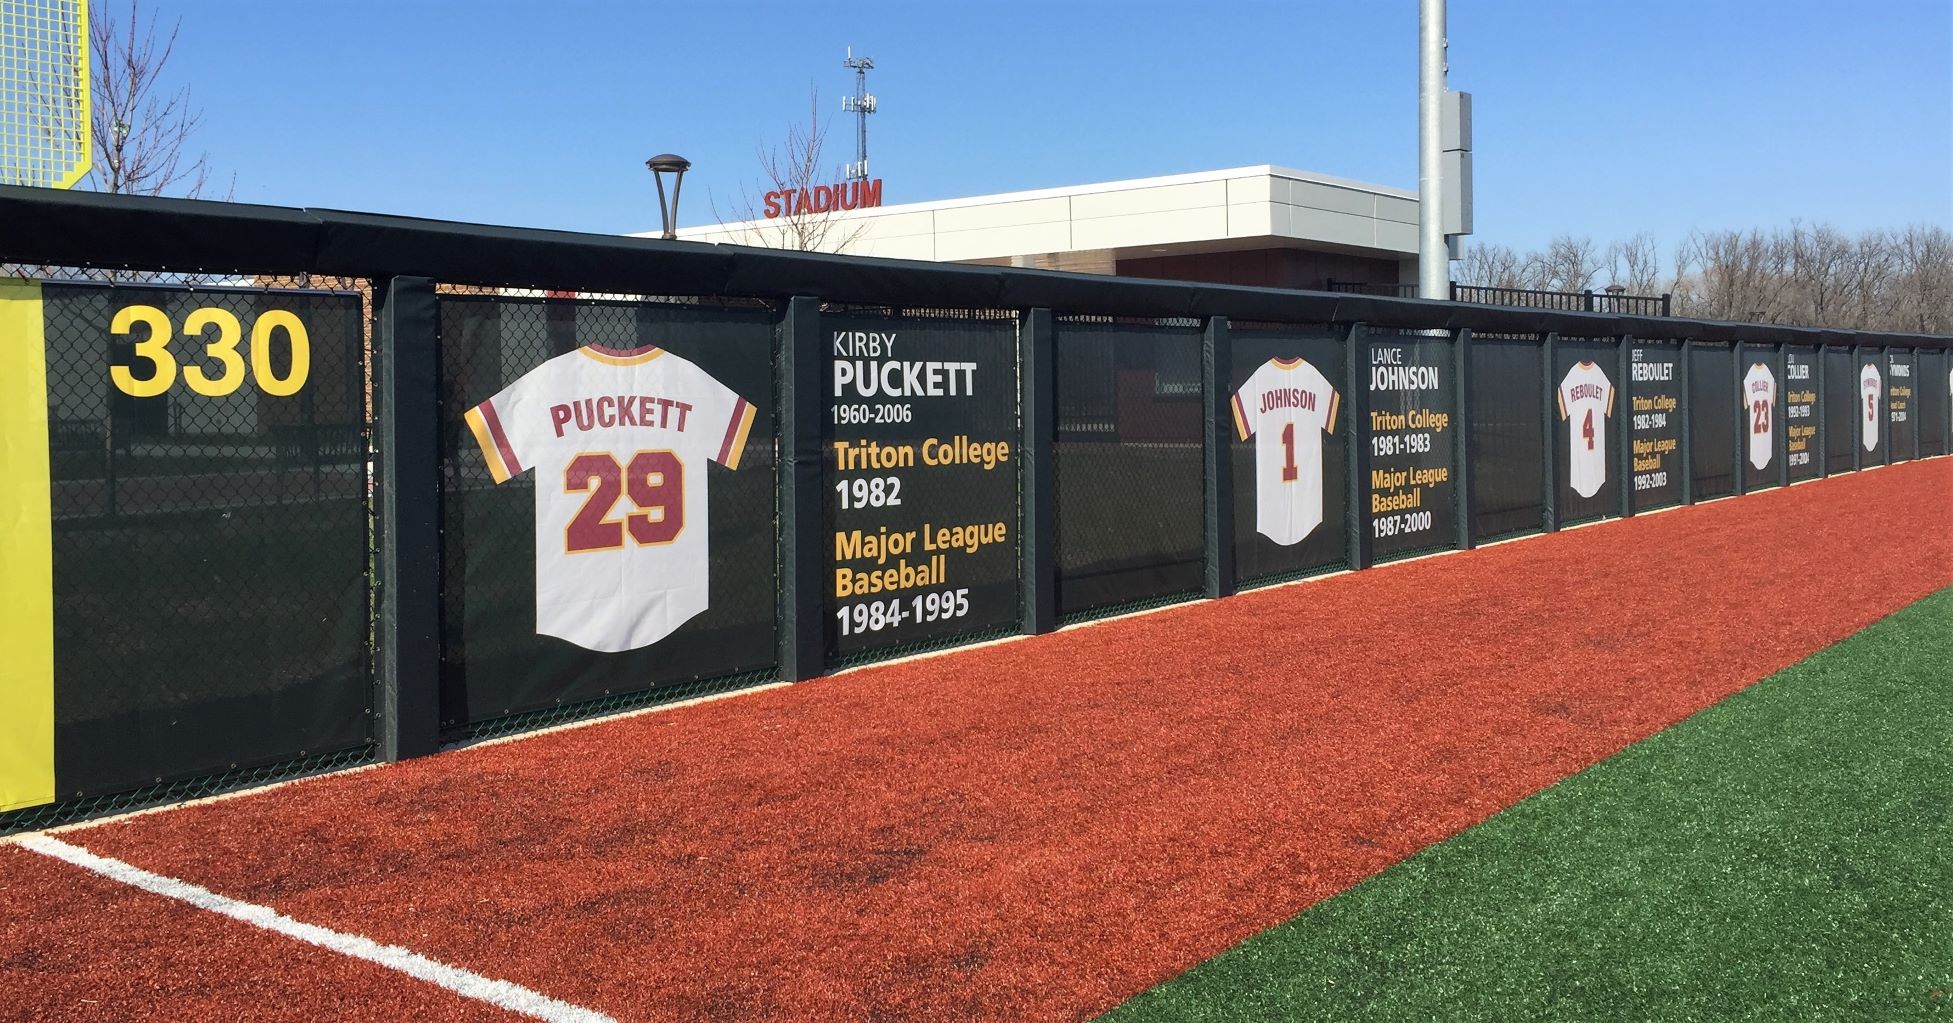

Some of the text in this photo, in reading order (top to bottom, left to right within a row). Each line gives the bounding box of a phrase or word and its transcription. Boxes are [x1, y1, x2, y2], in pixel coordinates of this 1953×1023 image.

[763, 178, 882, 219] STADIUM
[109, 305, 310, 398] 330
[833, 331, 896, 357] KIRBY
[1371, 347, 1402, 364] LANCE
[833, 360, 977, 397] PUCKETT
[1369, 366, 1439, 391] JOHNSON
[1632, 363, 1673, 381] REBOULET
[1570, 383, 1604, 403] REBOULET
[1751, 380, 1769, 394] COLLIER
[830, 403, 912, 424] 1960-2006
[1260, 388, 1316, 414] JOHNSON
[1632, 395, 1677, 412] Triton College
[1868, 394, 1874, 422] 5
[550, 396, 693, 438] PUCKETT
[1371, 409, 1449, 433] Triton College
[1582, 408, 1595, 450] 4
[1633, 413, 1667, 430] 1982-1984
[1753, 400, 1769, 434] 23
[834, 435, 1009, 471] Triton College
[1281, 422, 1298, 483] 1
[1371, 433, 1431, 457] 1981-1983
[1633, 439, 1676, 457] Major League
[1633, 454, 1661, 472] Baseball
[1371, 467, 1448, 492] Major League
[1634, 472, 1667, 491] 1992-2003
[563, 448, 686, 556] 29
[835, 476, 902, 510] 1982
[1371, 488, 1421, 513] Baseball
[1372, 511, 1432, 538] 1987-2000
[835, 521, 1007, 565] Major League
[835, 555, 947, 598] Baseball
[836, 588, 970, 636] 1984-1995
